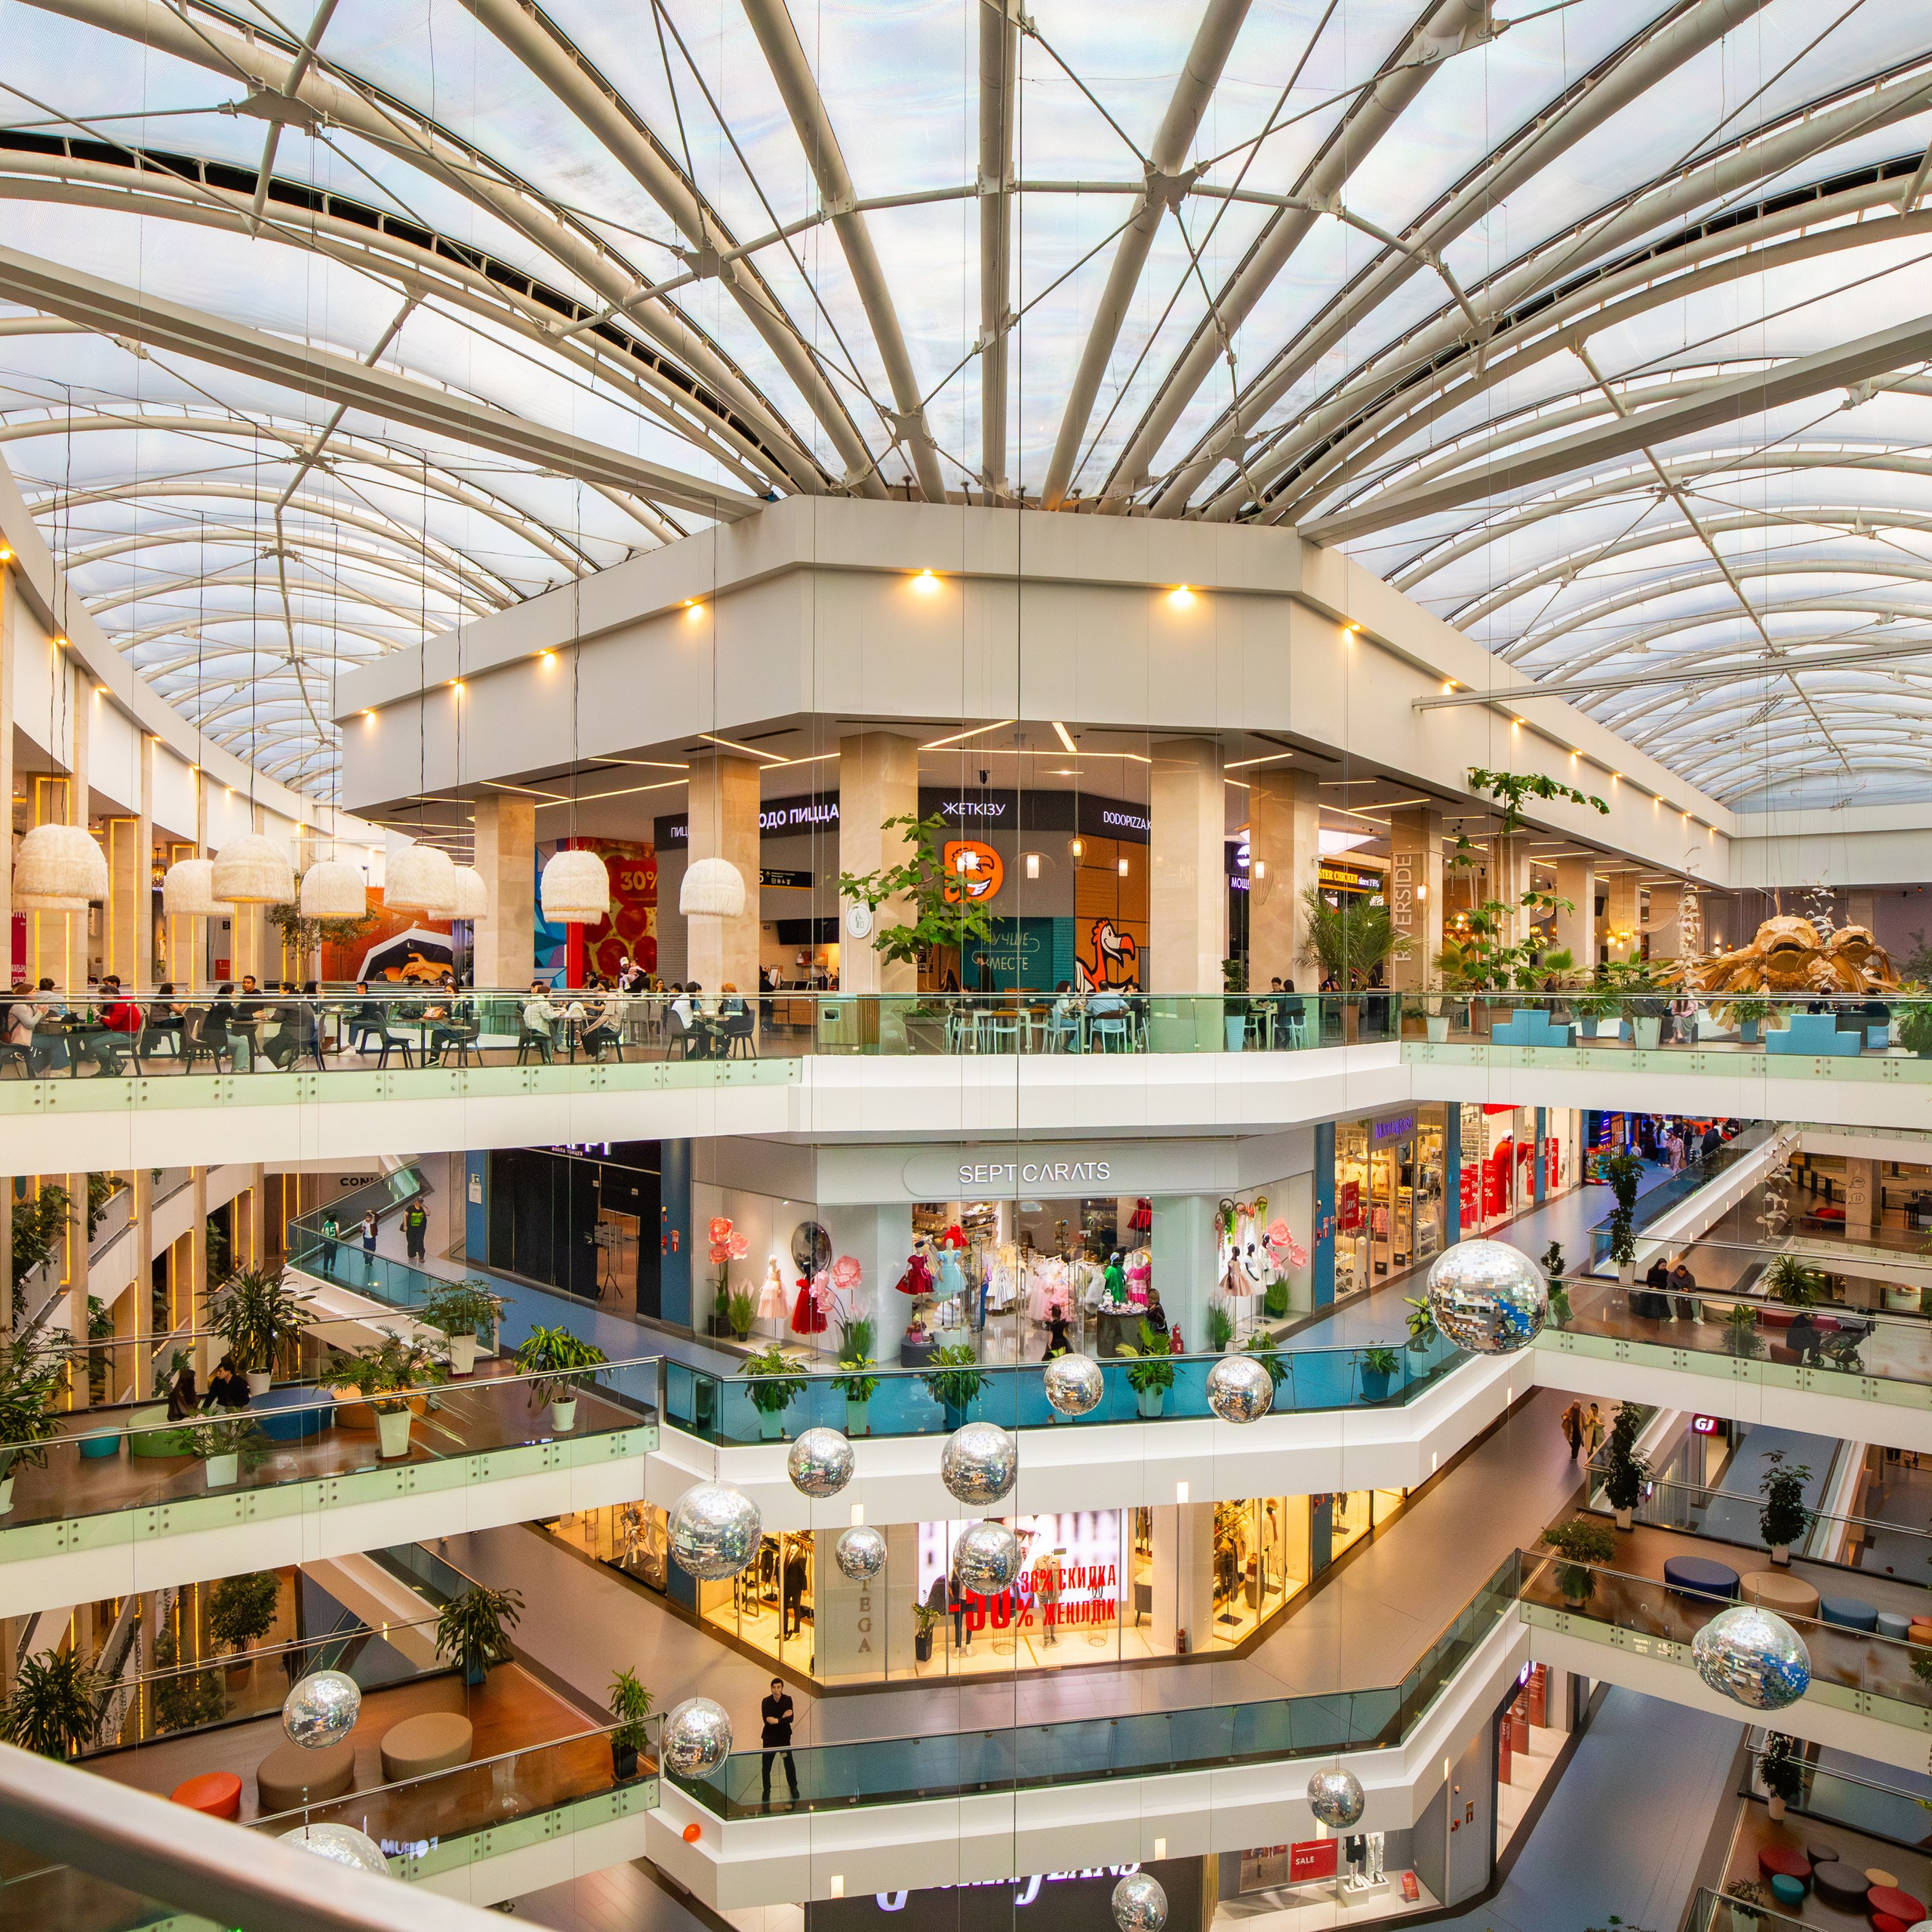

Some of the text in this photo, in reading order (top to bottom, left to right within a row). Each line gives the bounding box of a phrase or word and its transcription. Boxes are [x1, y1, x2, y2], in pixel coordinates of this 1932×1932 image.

[759, 804, 839, 829] ОДО ПИЦЦА
[943, 802, 1006, 816] ЖЕТКІЗУ
[1318, 869, 1334, 881] STER
[1334, 871, 1358, 884] CHICKEN
[1395, 855, 1411, 961] RVERSIDE
[986, 957, 1029, 971] МЕСТЕ
[959, 1162, 1110, 1183] SEPT CARATS
[340, 1177, 374, 1186] CON
[1695, 1417, 1715, 1432] GJ
[1059, 1564, 1116, 1592] СКИДКА
[1043, 1598, 1115, 1626] ЖЕҢІЛДІК
[1295, 1856, 1315, 1866] SALE
